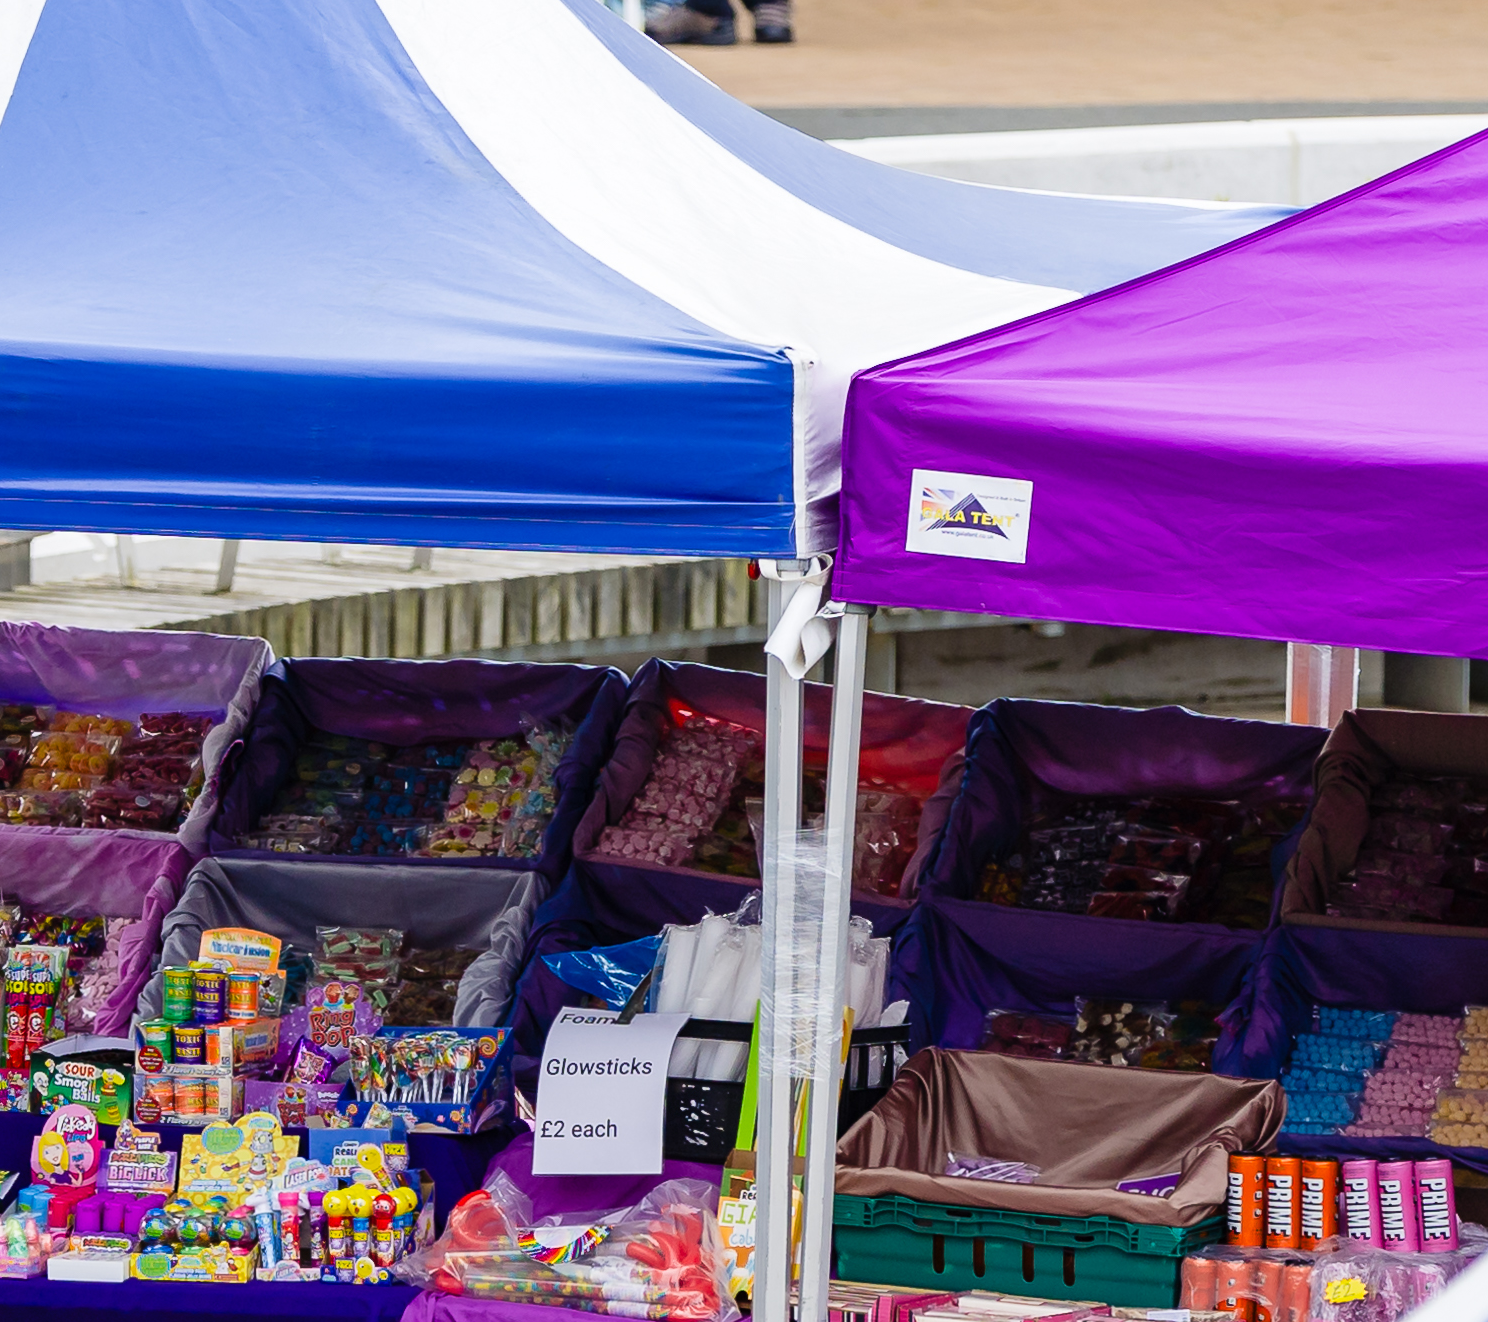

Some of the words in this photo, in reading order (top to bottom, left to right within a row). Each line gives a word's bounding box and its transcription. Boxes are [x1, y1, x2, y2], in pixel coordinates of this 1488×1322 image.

[922, 507, 965, 523] GALA
[971, 511, 1015, 527] TENT
[212, 940, 242, 954] Nuclear
[196, 979, 220, 989] TOXIC
[309, 1010, 354, 1031] Ring
[560, 1013, 618, 1024] Foam
[176, 1035, 201, 1044] TOXIC
[65, 1064, 95, 1077] SOUR
[546, 1057, 653, 1076] Glowsticks
[54, 1074, 88, 1091] Smog
[72, 1088, 101, 1103] Balls
[541, 1120, 565, 1138] £2
[571, 1119, 618, 1138] each
[109, 1166, 132, 1181] BiG
[134, 1166, 167, 1181] LiCK
[285, 1170, 307, 1188] LASER
[1228, 1173, 1243, 1234] PRIME
[1268, 1174, 1293, 1237] PRIME
[1302, 1178, 1324, 1240] PRIME
[1345, 1178, 1371, 1241] PRIME
[1379, 1180, 1406, 1242] PRIME
[1420, 1178, 1452, 1242] PRIME
[730, 1229, 755, 1246] cab
